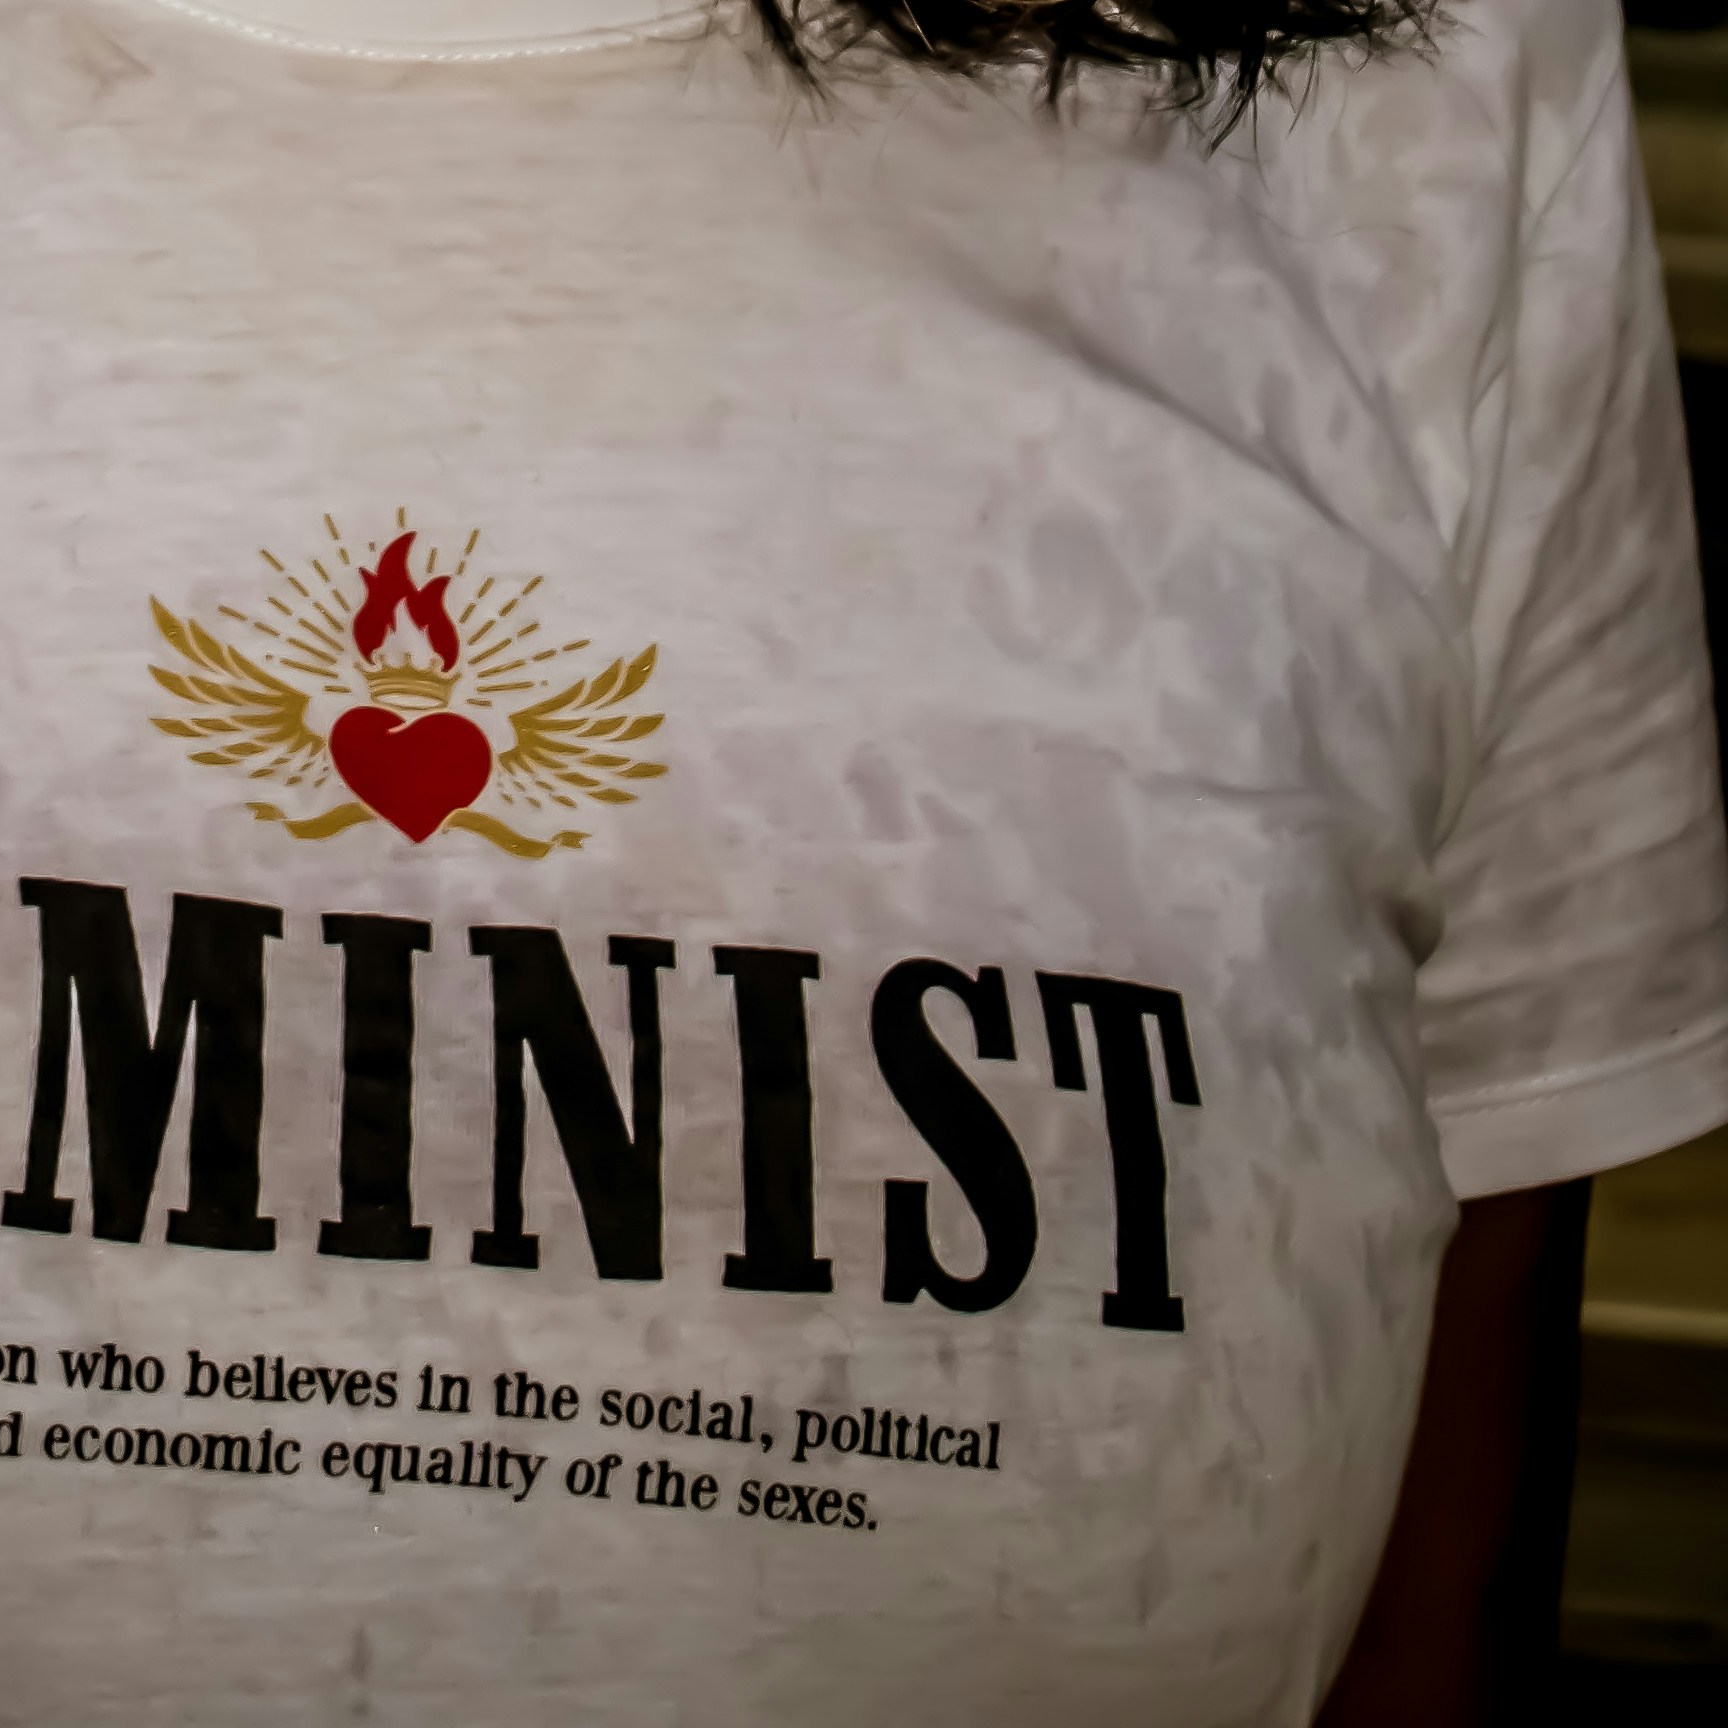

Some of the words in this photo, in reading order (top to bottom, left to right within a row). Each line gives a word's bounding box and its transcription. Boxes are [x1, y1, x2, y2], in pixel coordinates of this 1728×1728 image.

[57, 1342, 166, 1394] who
[183, 1349, 398, 1409] believes
[416, 1364, 472, 1414] in
[493, 1371, 580, 1421] the
[599, 1389, 775, 1454] social,
[790, 1406, 1001, 1472] political
[42, 1423, 301, 1476] economic
[321, 1440, 549, 1503] equality
[564, 1453, 623, 1500] of
[635, 1458, 719, 1512] the
[737, 1478, 878, 1532] sexes.
